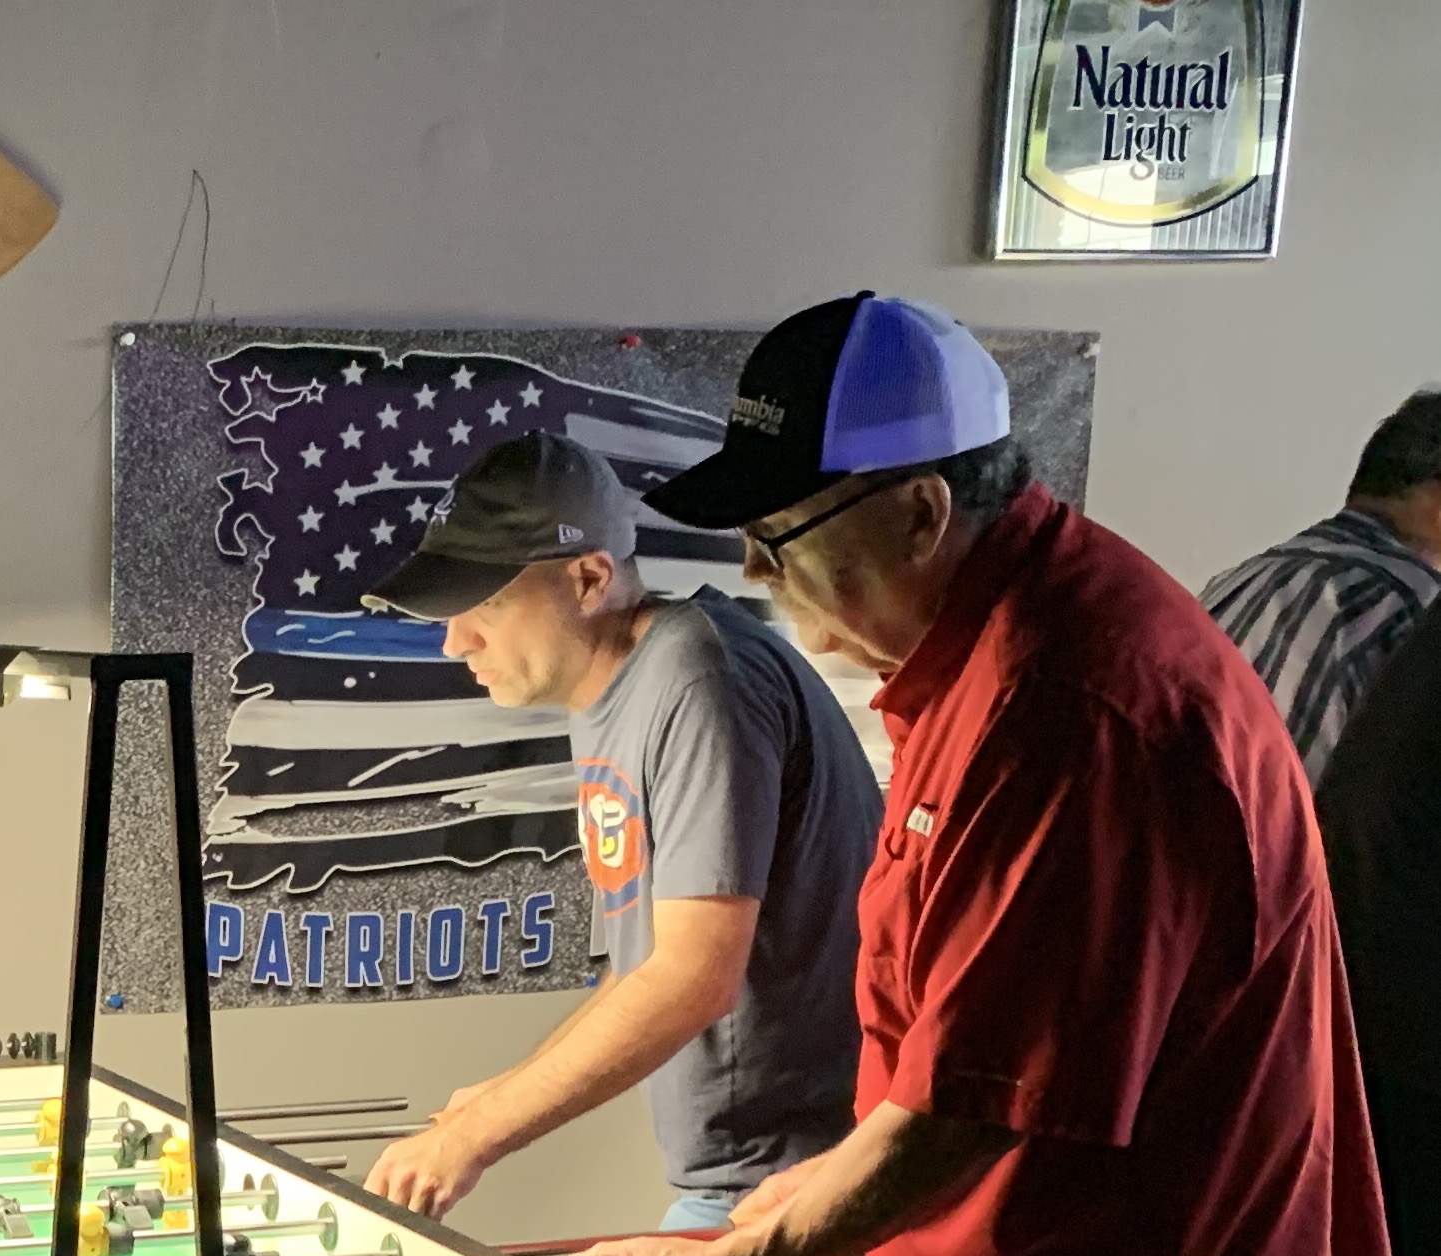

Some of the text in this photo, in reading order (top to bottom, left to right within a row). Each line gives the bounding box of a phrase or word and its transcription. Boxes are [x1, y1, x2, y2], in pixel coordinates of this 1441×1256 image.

[1072, 44, 1231, 110] Natural
[1102, 113, 1191, 181] Light
[734, 394, 785, 424] umbia
[207, 892, 555, 987] PATRIOTS
